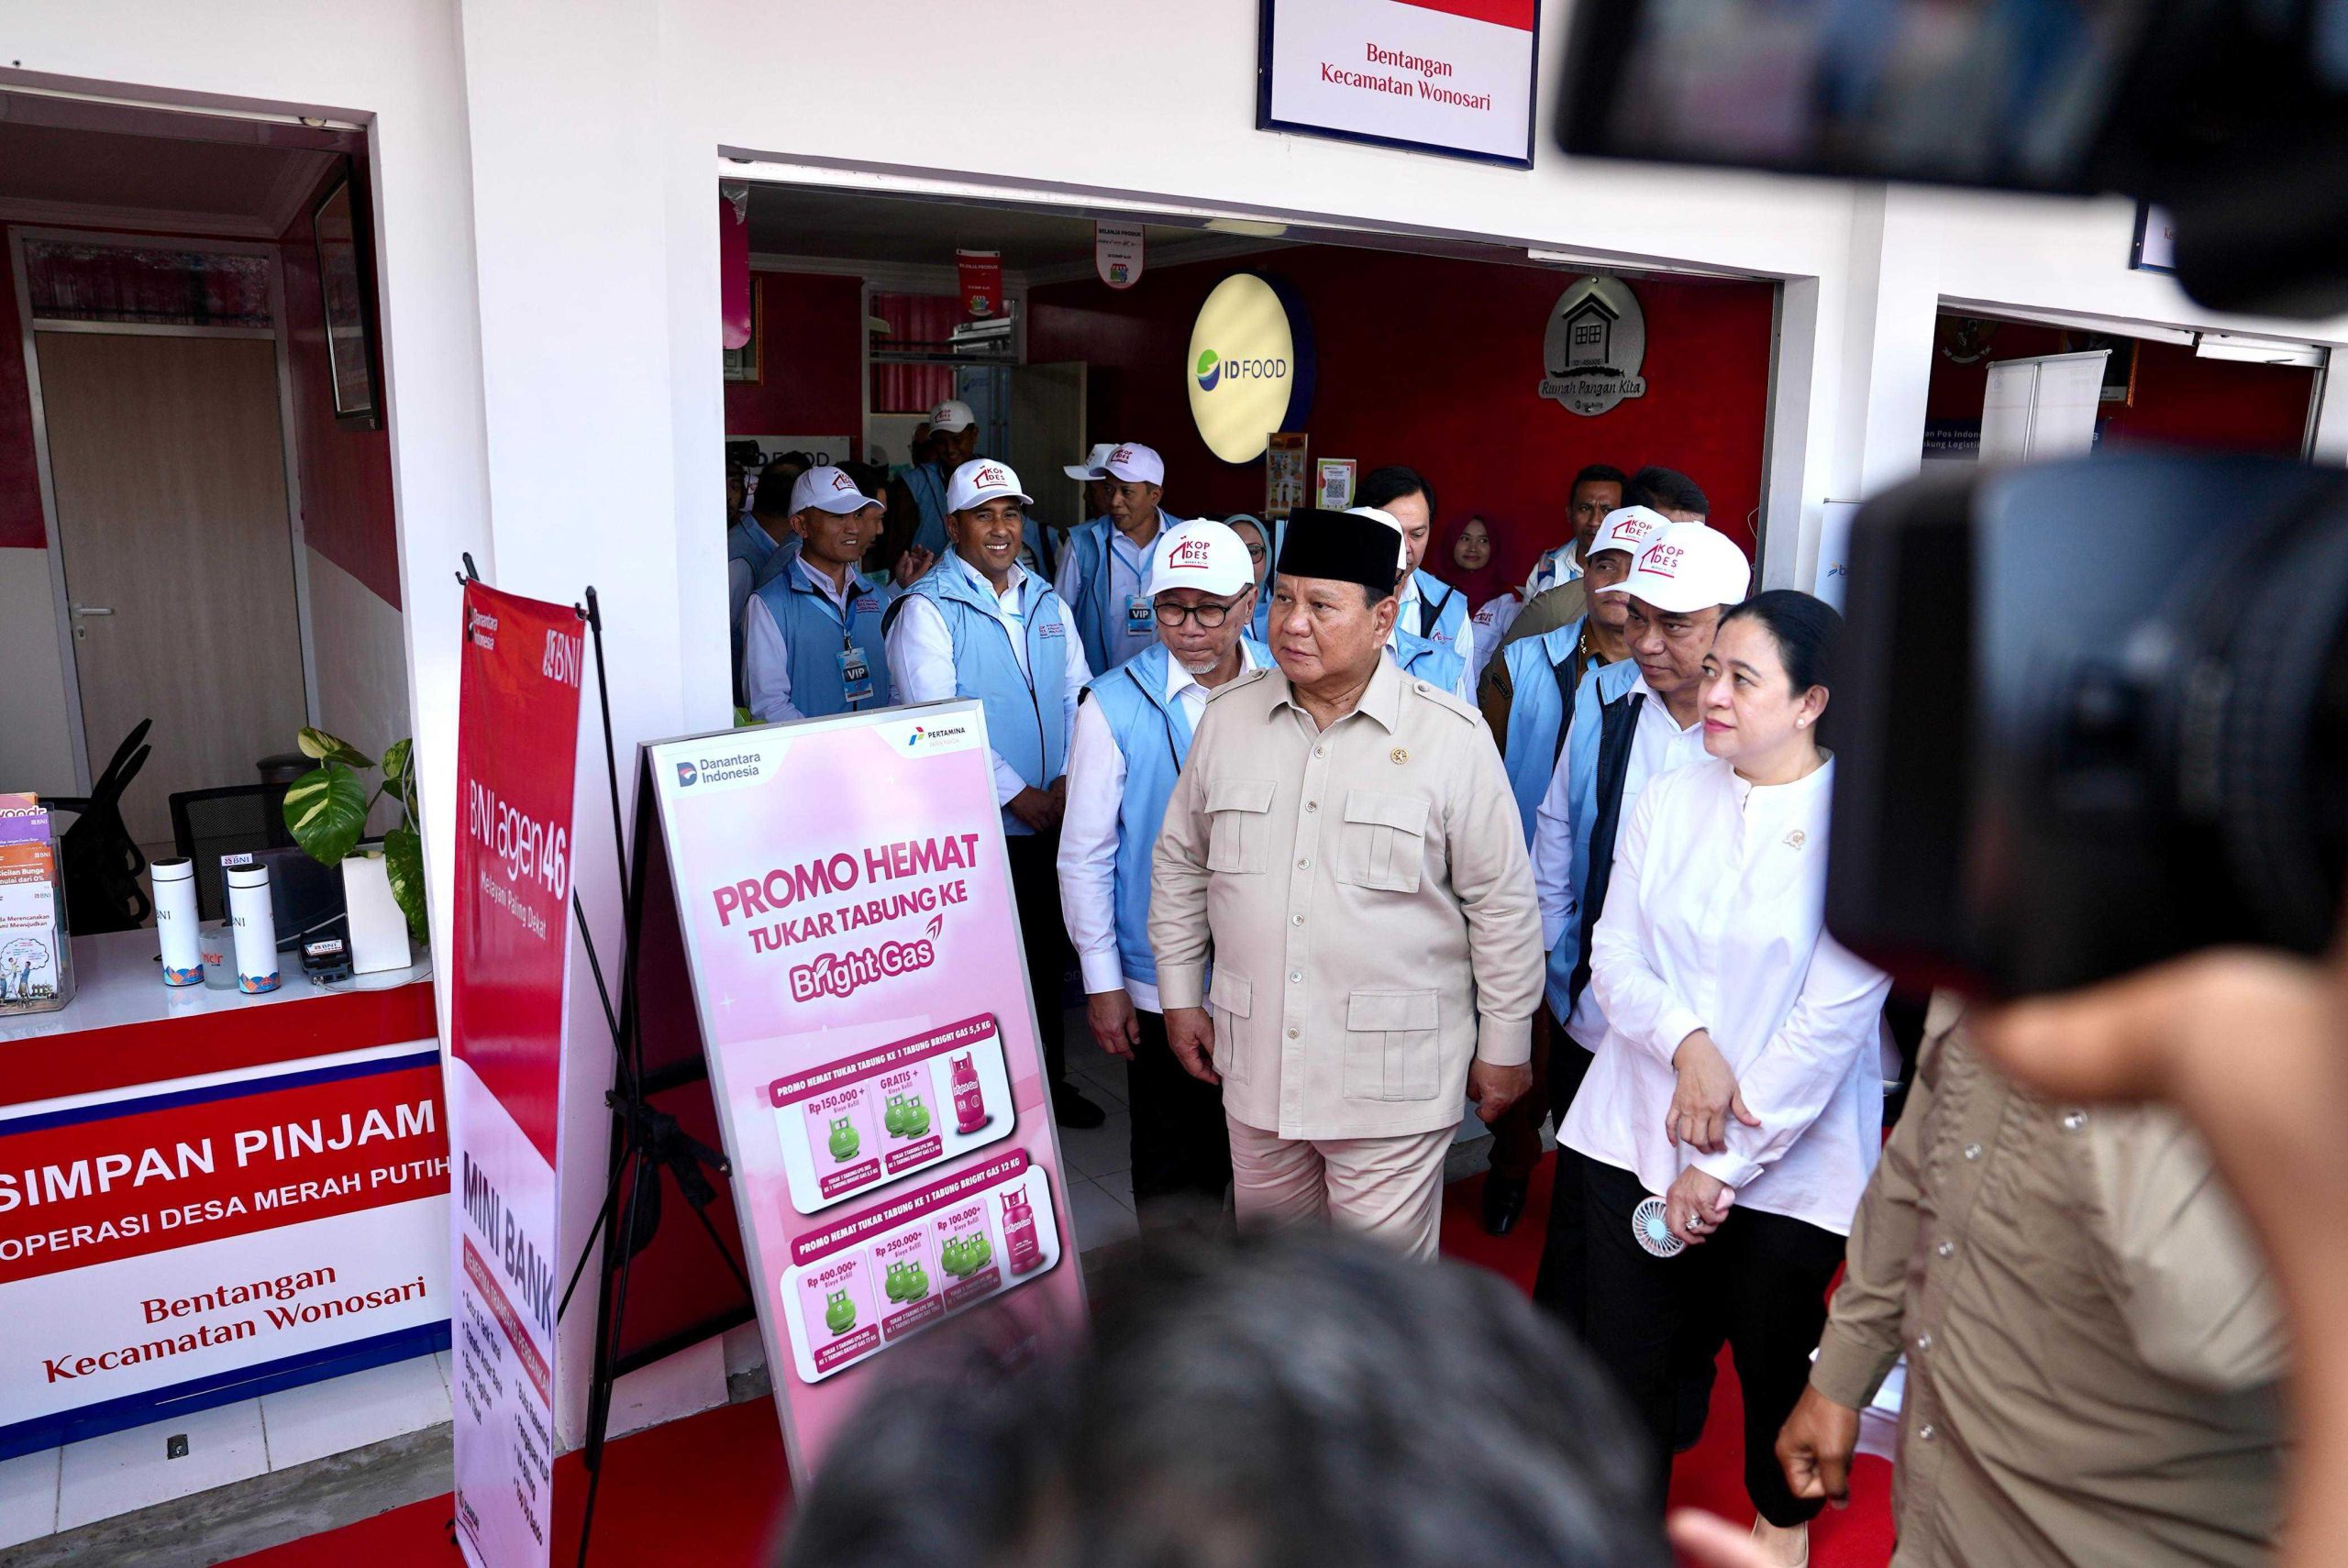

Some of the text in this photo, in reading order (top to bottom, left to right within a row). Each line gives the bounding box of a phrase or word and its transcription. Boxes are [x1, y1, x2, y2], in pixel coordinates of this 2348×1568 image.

[1366, 43, 1453, 78] Bentangan
[1321, 62, 1491, 111] Kecamatan Wonosari
[1224, 359, 1287, 379] ID FOOD
[1542, 380, 1641, 397] Rumah Pangan Kita
[1632, 520, 1653, 530] KOP
[1185, 550, 1208, 560] DES
[1186, 541, 1211, 550] KOP
[1657, 544, 1684, 558] KOP
[1654, 554, 1678, 568] DES
[1132, 610, 1148, 619] VIP
[554, 631, 581, 689] BNI
[847, 668, 865, 679] VIP
[927, 726, 966, 739] PERTAMINA
[700, 752, 761, 770] Danantara
[702, 765, 759, 784] Indonesia
[471, 778, 567, 900] BNI agen46
[232, 856, 250, 865] BNI
[713, 834, 979, 927] PROMO HEMAT
[481, 869, 547, 941] Melayani Paling Dekat
[748, 879, 969, 954] TUKAR TABUNG KE
[10, 921, 48, 929] Mewujudkan
[792, 940, 934, 1000] Bright Gas
[777, 1021, 991, 1098] PROMO HEMAT TUKAR TABUNG KE 1 TABUNG BRIGHT GAS 5,5 KG
[880, 1070, 911, 1089] GRATIS
[0, 1099, 436, 1213] SIMPAN PINJAM
[161, 1196, 247, 1230] DESA
[255, 1173, 362, 1211] MERAH
[370, 1155, 452, 1189] PUTIH
[799, 1157, 1020, 1255] PROMO HEMAT TUKAR TABUNG KE 1 TABUNG BRIGHT GAS 12 KG
[937, 1207, 981, 1231] Rp 100.000+
[463, 1150, 553, 1342] MINI BANK
[876, 1231, 923, 1257] Rp 250.000+
[807, 1261, 858, 1288] Rp 400.000+
[141, 1264, 337, 1324] Bentangan
[42, 1275, 426, 1384] Kecamatan Wonosari
